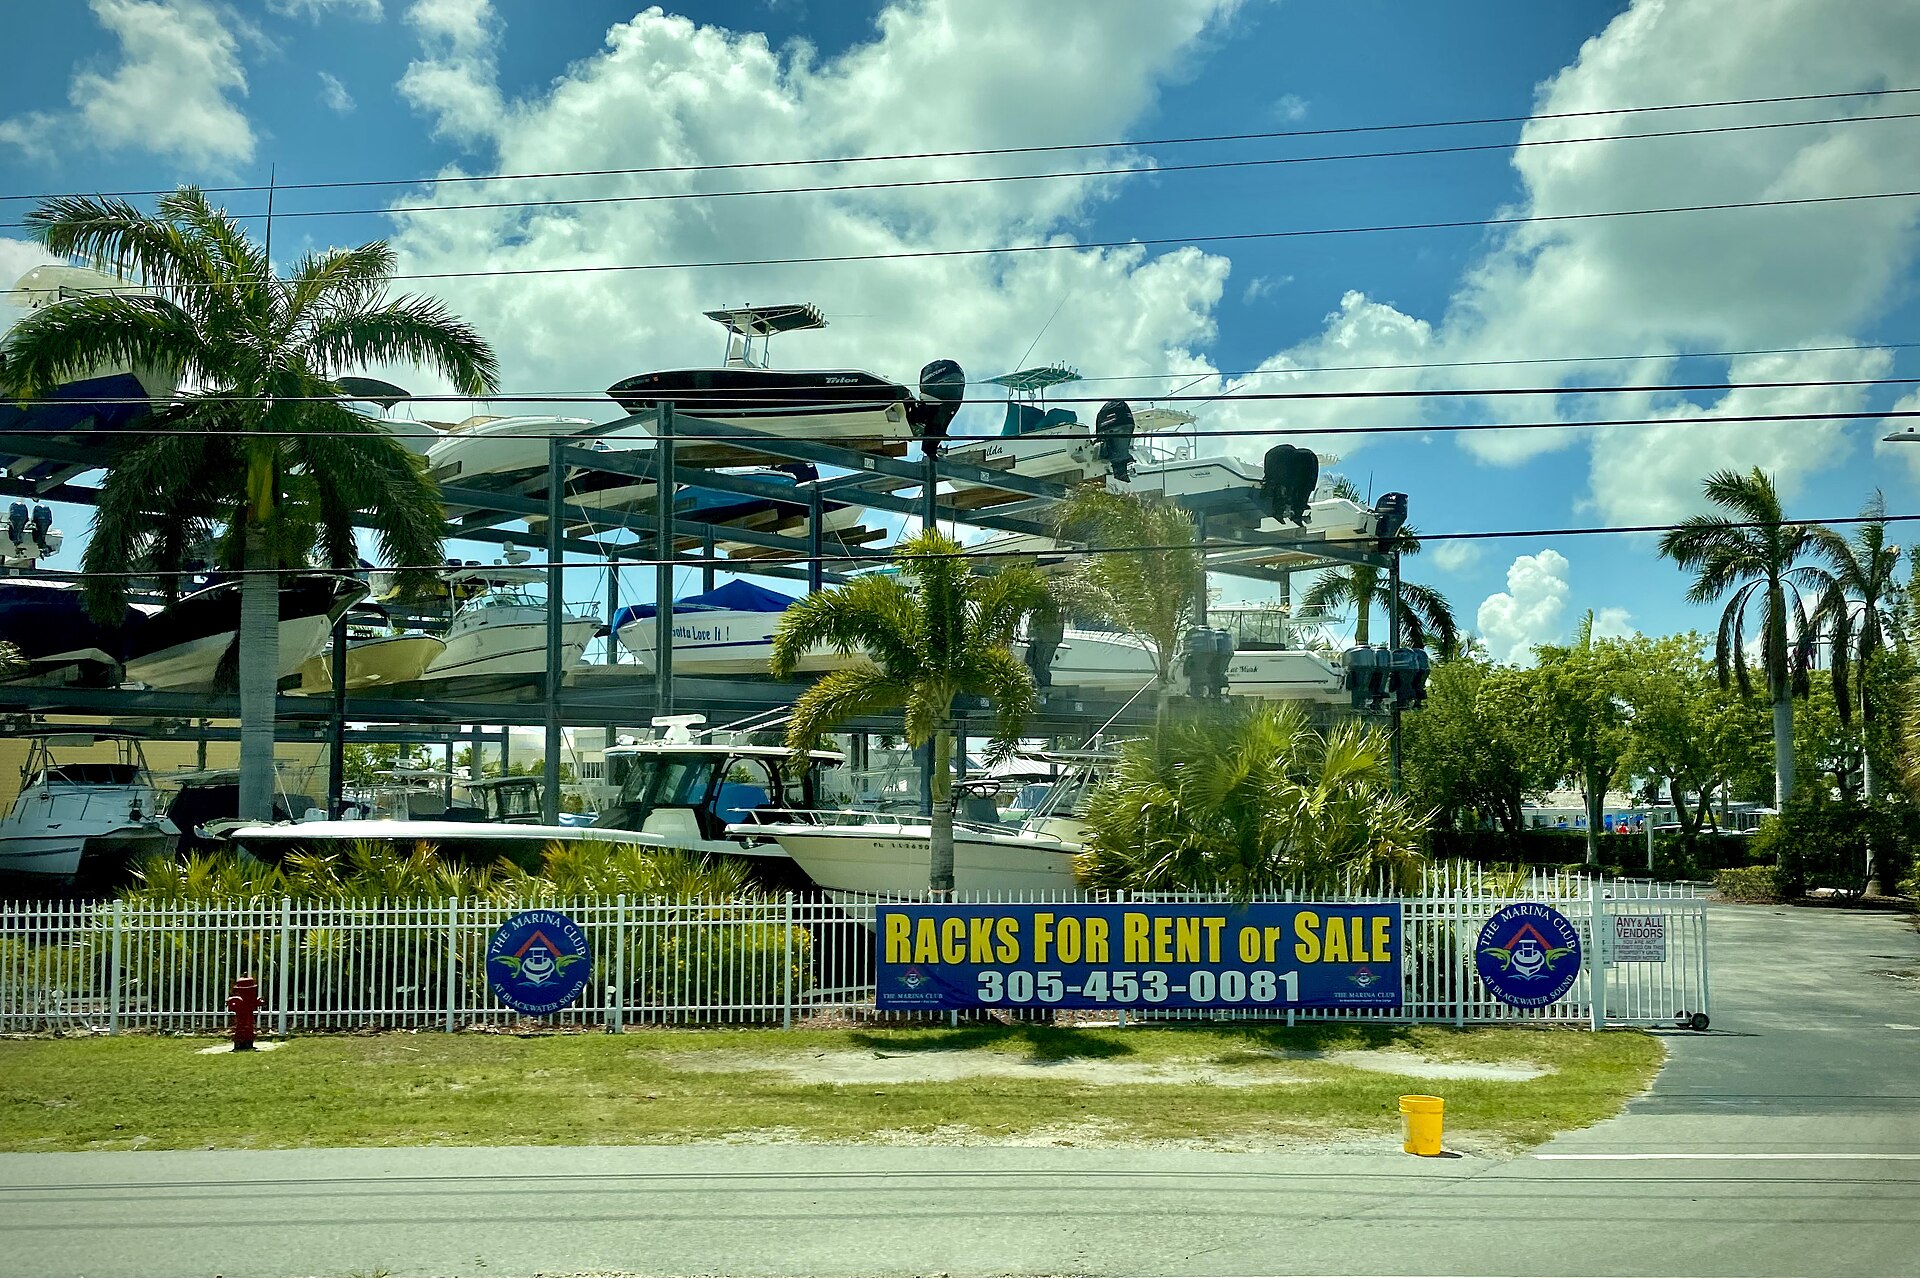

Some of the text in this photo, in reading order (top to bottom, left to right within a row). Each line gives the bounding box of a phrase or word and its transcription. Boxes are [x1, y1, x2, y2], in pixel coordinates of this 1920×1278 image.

[692, 626, 711, 640] Love
[714, 626, 721, 641] It
[490, 913, 586, 956] THE MARINA CLUB
[885, 911, 1392, 964] RACKS FOR RENT or SALE
[1480, 921, 1500, 946] THE
[1500, 905, 1550, 922] MARINA
[1553, 917, 1576, 949] CLUB
[1616, 928, 1663, 938] VENDORS
[1644, 917, 1663, 927] ALL
[494, 980, 584, 1012] AT BLACKWATER SOUND
[977, 970, 1299, 1003] 305-453-0081
[1483, 974, 1574, 1006] AT BLACKWATER SOUND
